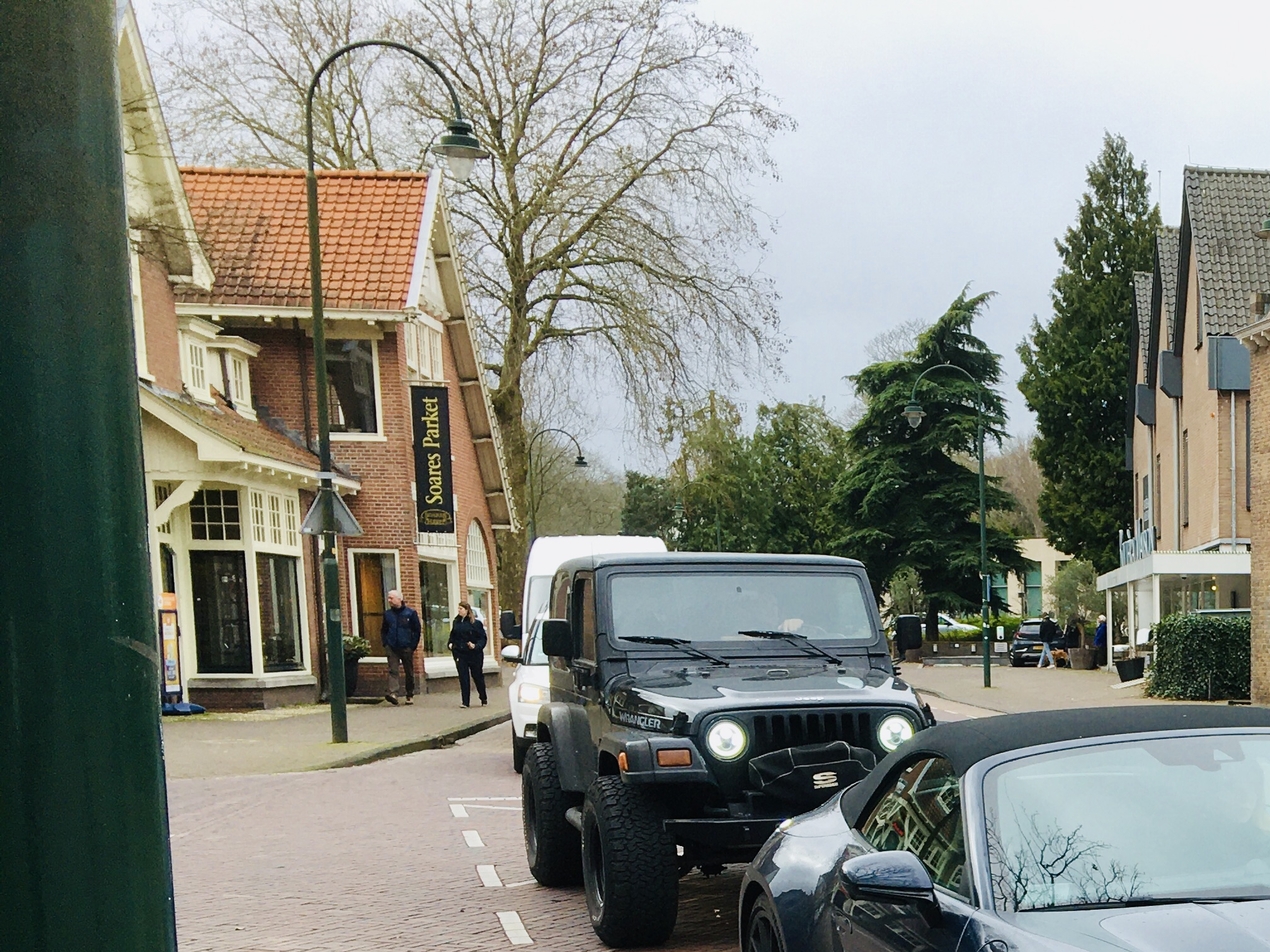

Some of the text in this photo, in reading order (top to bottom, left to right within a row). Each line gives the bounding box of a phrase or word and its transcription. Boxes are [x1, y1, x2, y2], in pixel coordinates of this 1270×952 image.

[421, 396, 441, 448] Parket
[425, 453, 443, 505] Soares
[619, 711, 661, 729] WRANGLER
